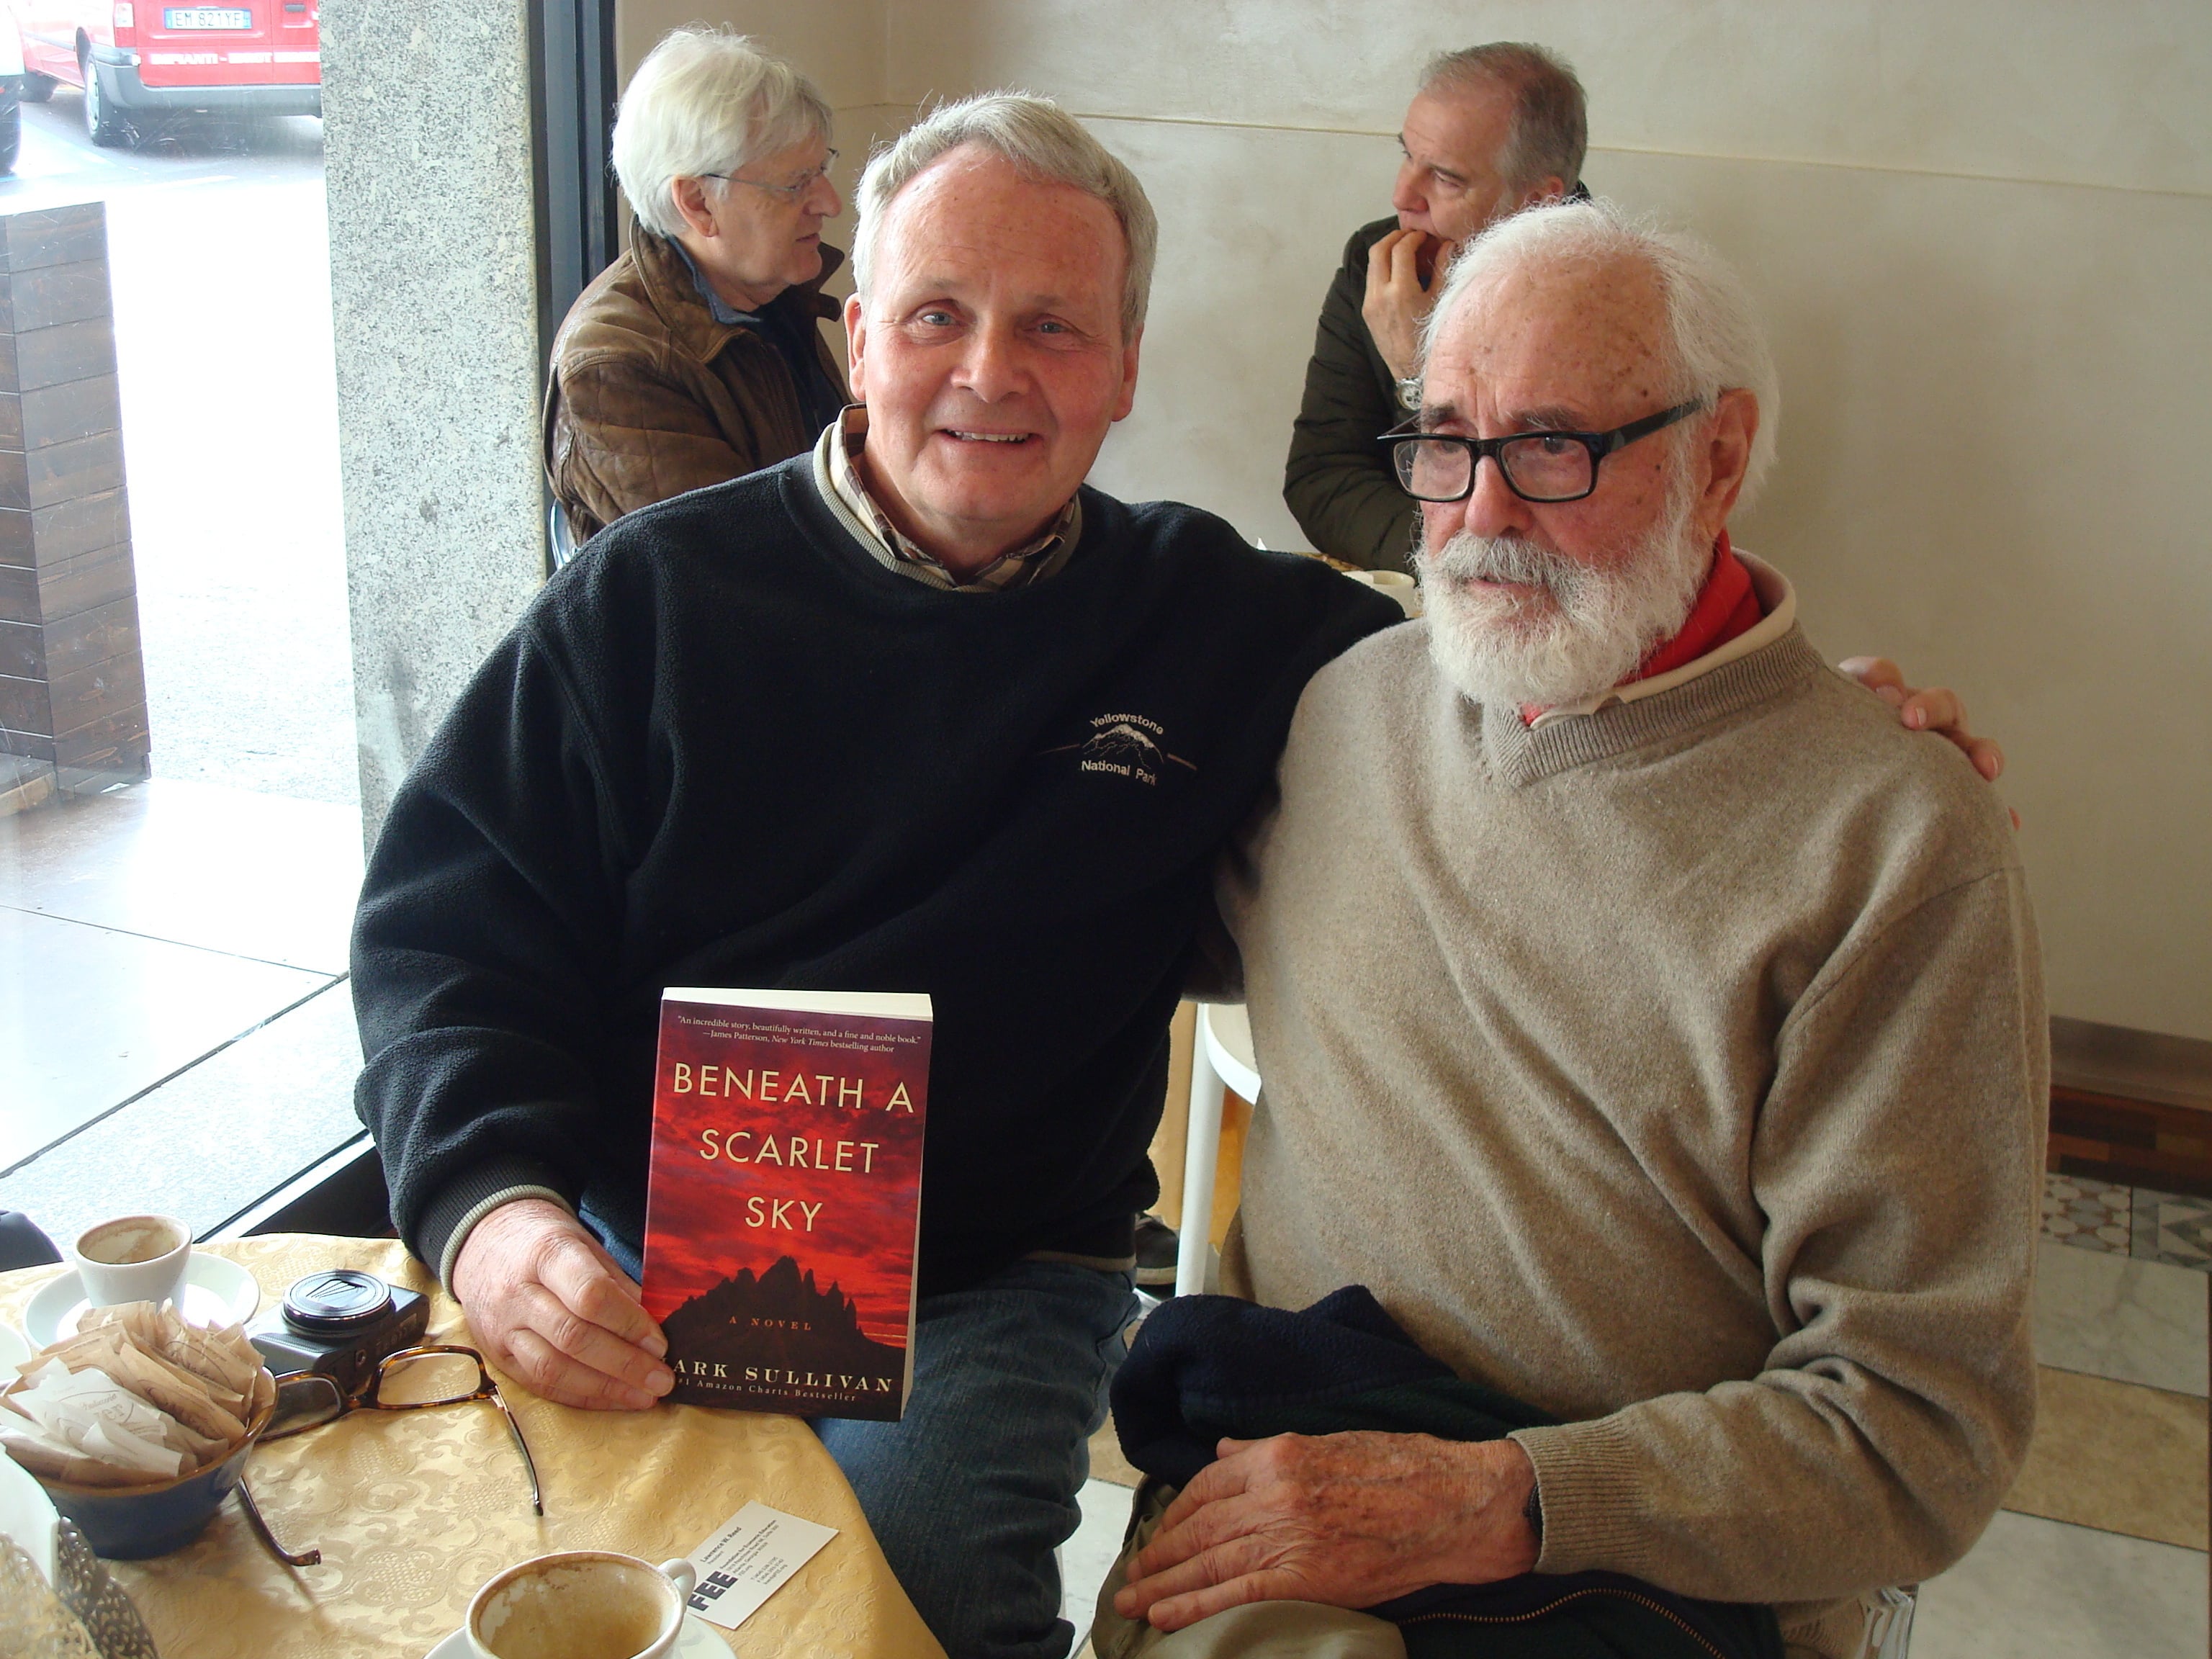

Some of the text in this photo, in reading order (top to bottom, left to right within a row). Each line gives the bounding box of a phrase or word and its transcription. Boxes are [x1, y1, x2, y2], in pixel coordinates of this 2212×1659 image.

[175, 12, 192, 27] EM
[1089, 713, 1164, 735] Yellowstone
[1081, 760, 1158, 786] National Park
[693, 1017, 729, 1028] incredible
[730, 1021, 751, 1030] story,
[752, 1022, 791, 1035] beautifully
[793, 1027, 822, 1037] written,
[822, 1029, 837, 1038] and
[844, 1030, 858, 1039] fine
[876, 1034, 896, 1043] noble
[734, 1031, 770, 1043] Patterson,
[772, 1035, 788, 1044] New
[790, 1036, 806, 1046] York
[808, 1038, 830, 1047] Times
[830, 1040, 869, 1053] bestselling
[870, 1044, 894, 1053] author
[673, 1062, 914, 1114] BENEATH A
[699, 1128, 880, 1174] SCARLET
[745, 1196, 824, 1233] SKY
[729, 1316, 811, 1331] A NOVEL
[663, 1357, 894, 1393] ARK SULLIVAN
[697, 1380, 742, 1392] Amazon
[748, 1385, 788, 1395] Charts
[795, 1389, 856, 1402] Bestseller
[687, 1570, 738, 1611] FEE
